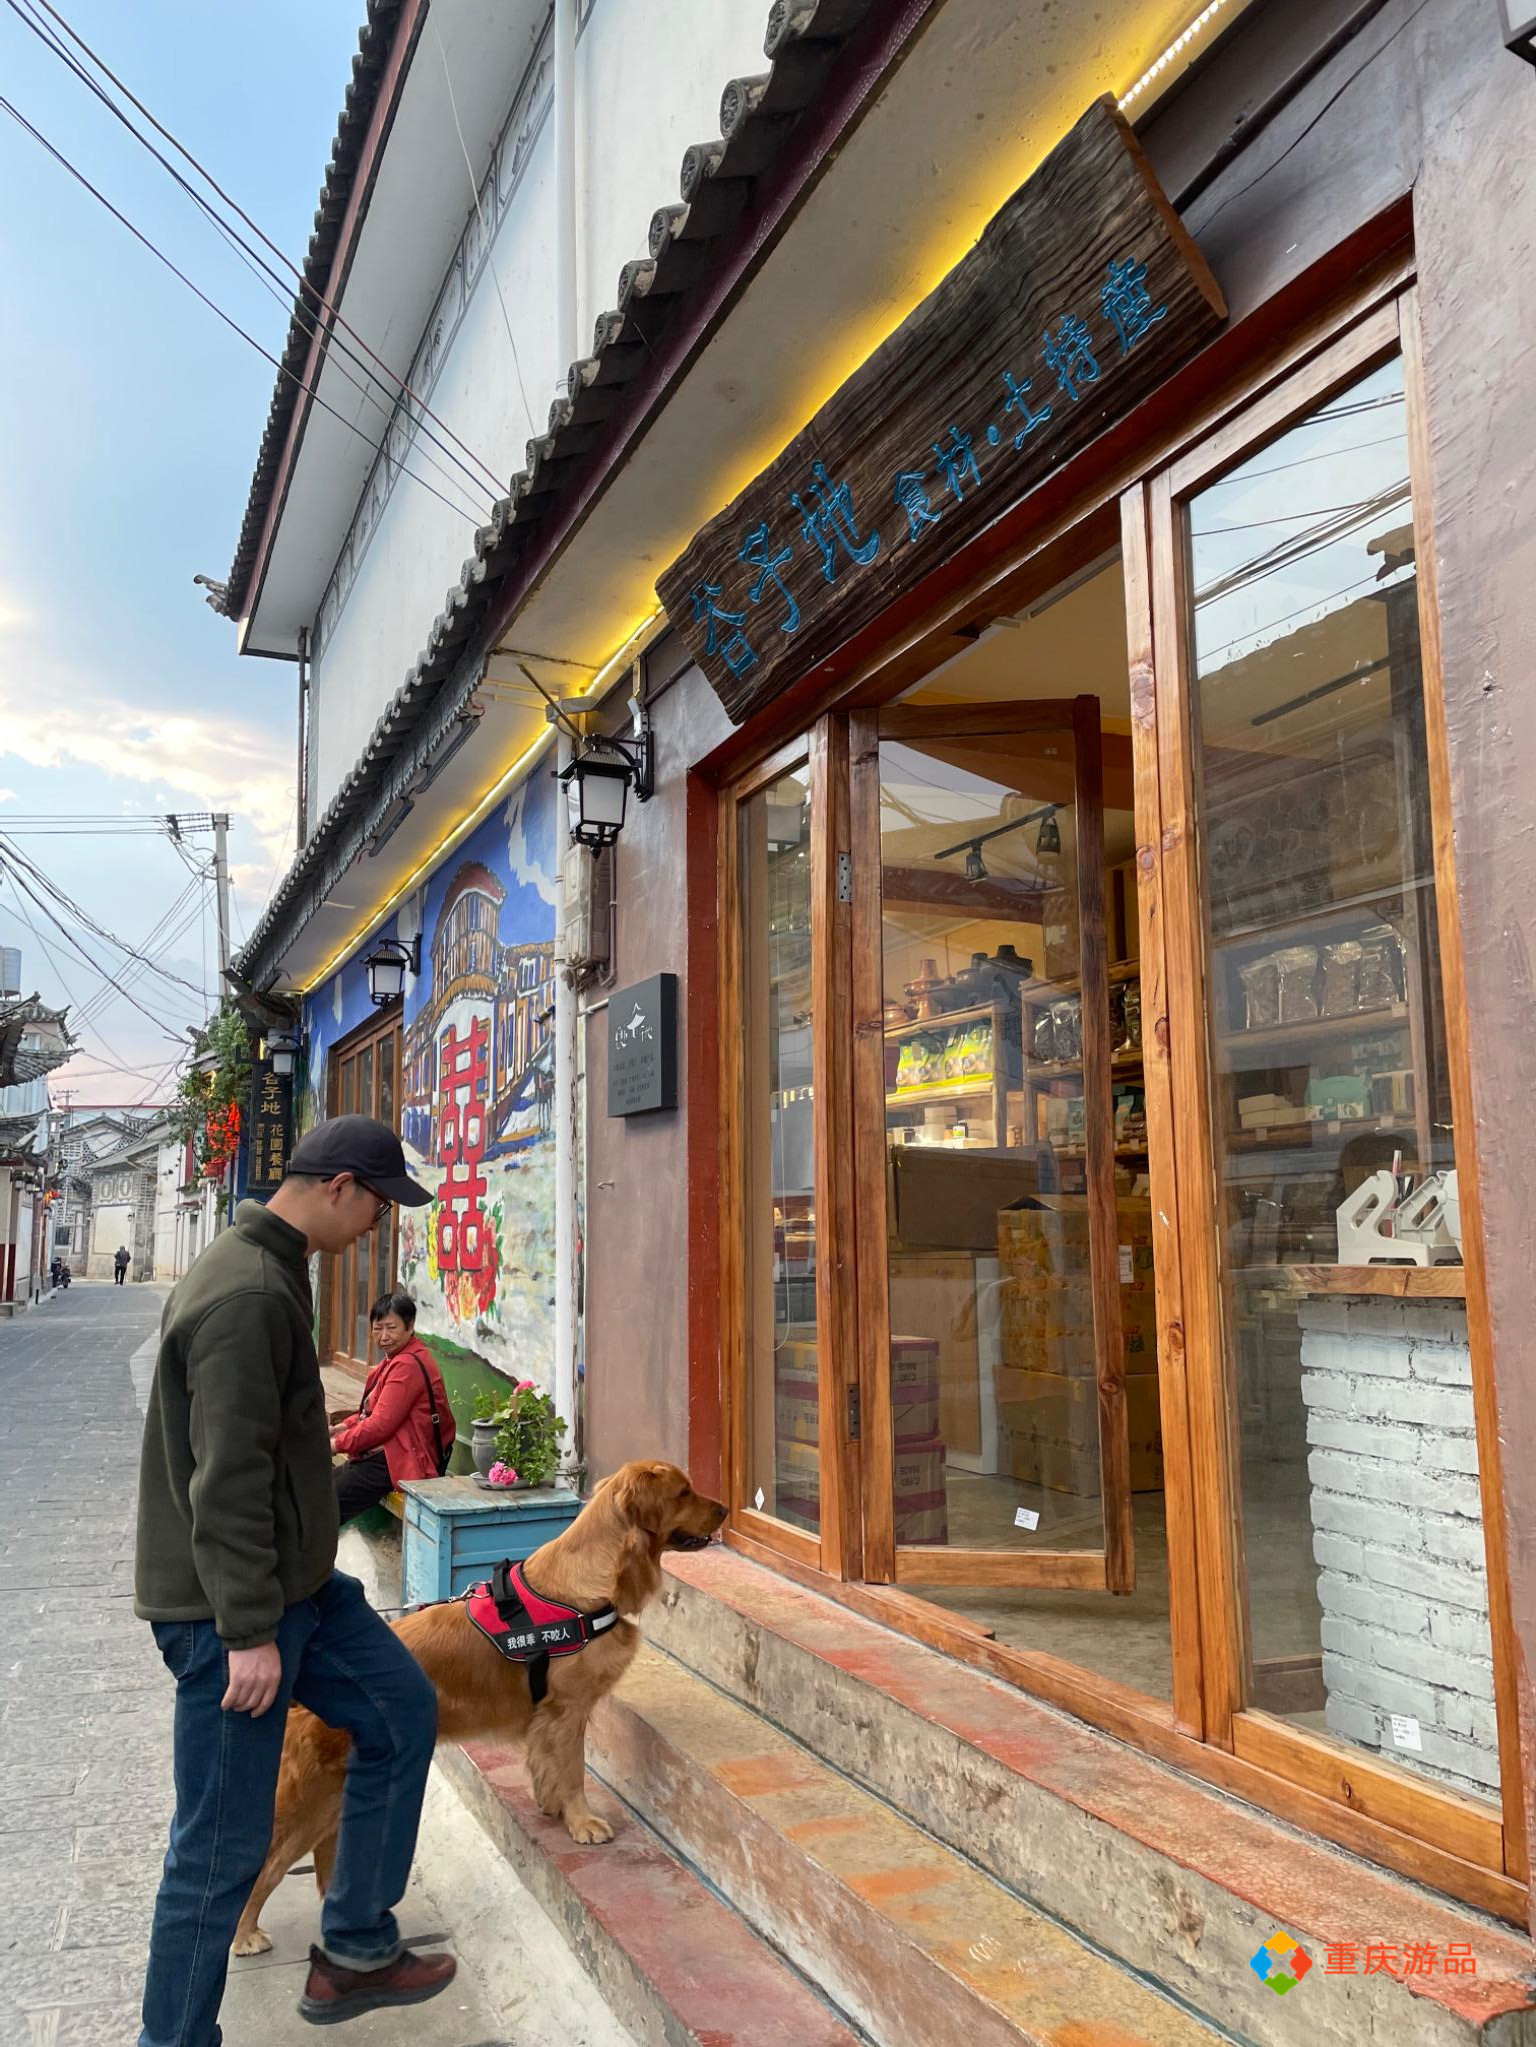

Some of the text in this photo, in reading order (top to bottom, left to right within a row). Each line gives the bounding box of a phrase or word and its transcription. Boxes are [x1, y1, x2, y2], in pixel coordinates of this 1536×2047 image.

[691, 460, 881, 680] 谷子地
[507, 1628, 570, 1649] 我很乖 不咬人
